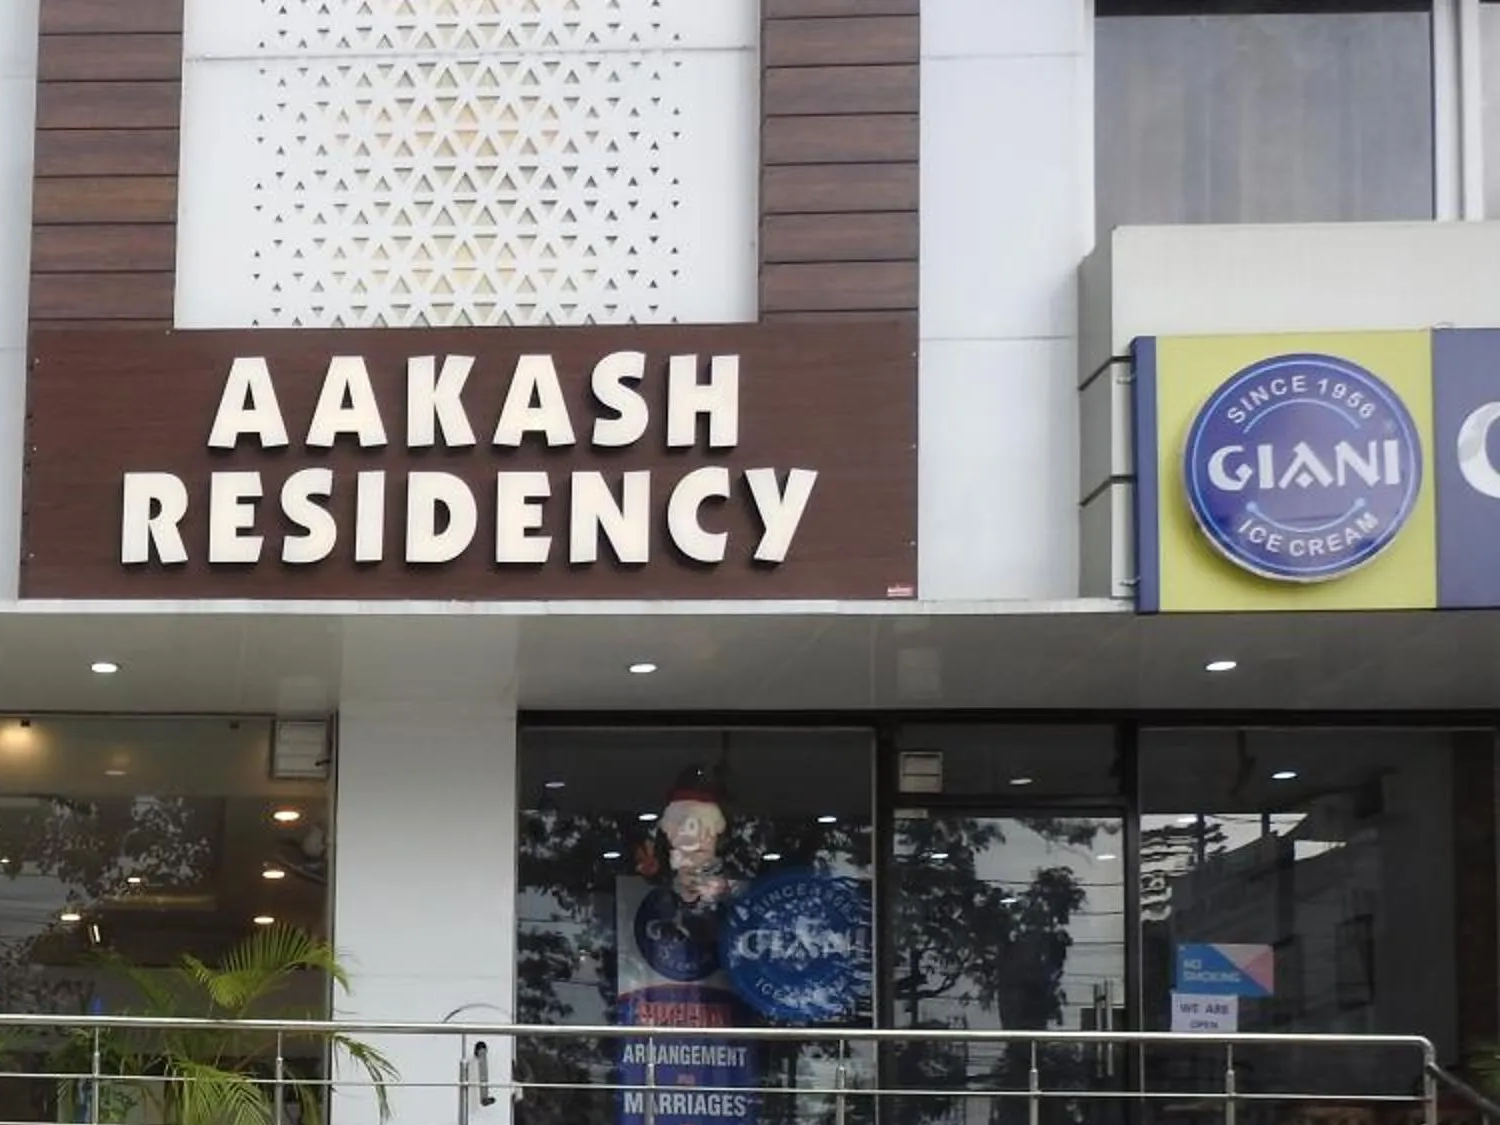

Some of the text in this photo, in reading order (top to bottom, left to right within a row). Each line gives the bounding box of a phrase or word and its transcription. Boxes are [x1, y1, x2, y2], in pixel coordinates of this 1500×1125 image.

[207, 351, 739, 448] AAKASH
[1228, 374, 1307, 424] SINCE
[1207, 439, 1401, 491] GIANI
[121, 466, 818, 564] RESIDENCY
[1238, 511, 1379, 557] ICE CREAM
[1180, 1003, 1230, 1015] WE ARE
